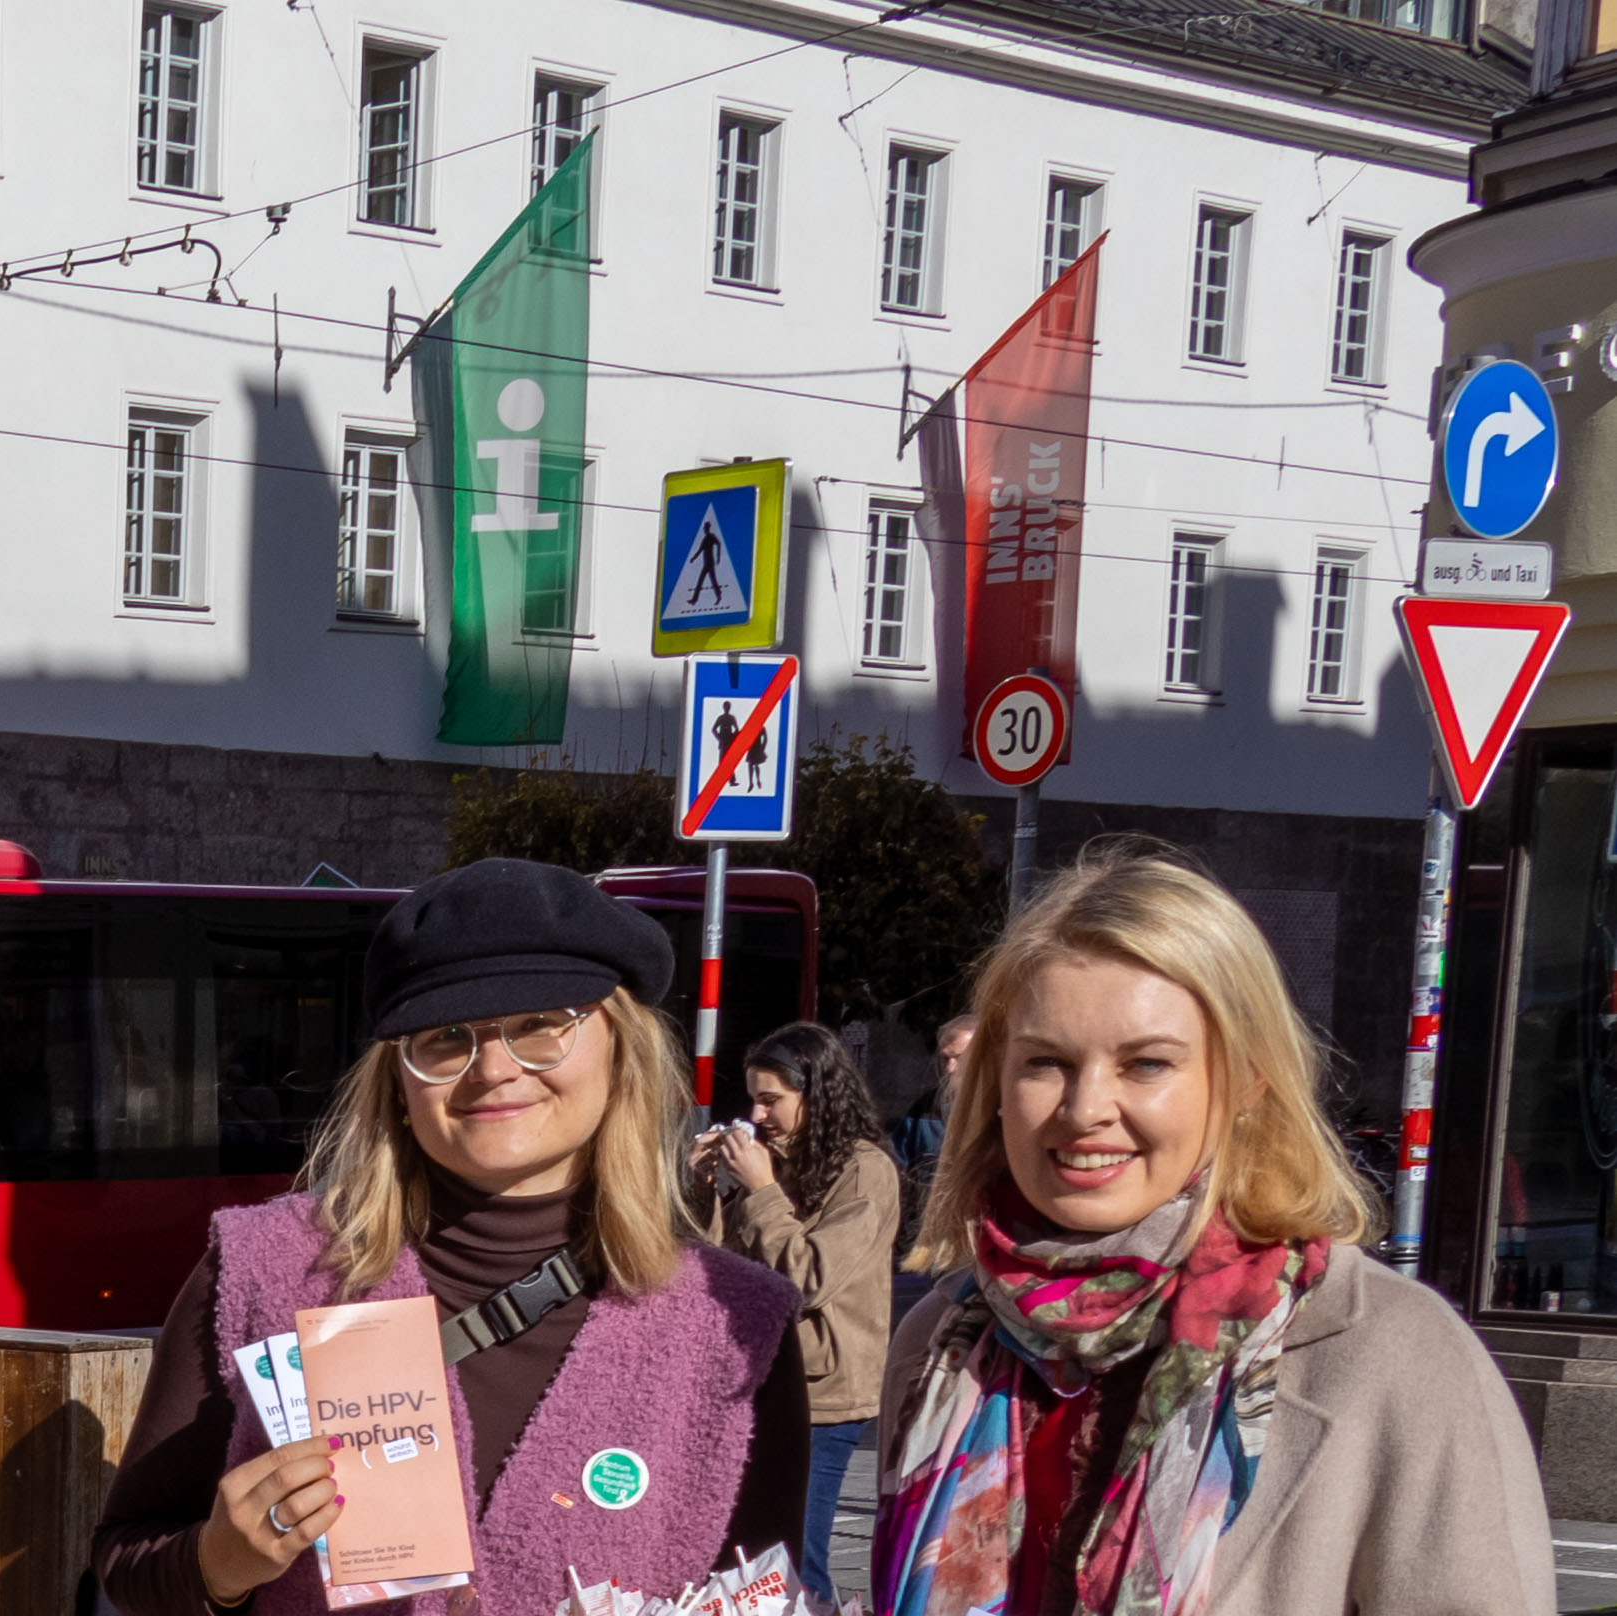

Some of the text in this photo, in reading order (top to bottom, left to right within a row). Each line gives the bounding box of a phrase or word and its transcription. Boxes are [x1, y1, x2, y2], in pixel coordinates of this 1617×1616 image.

[1021, 441, 1062, 582] BRUCK
[1433, 565, 1537, 583] ausg. und Taxi
[998, 708, 1042, 757] 30
[318, 1390, 437, 1421] Die HPV-
[321, 1423, 434, 1451] mpfung
